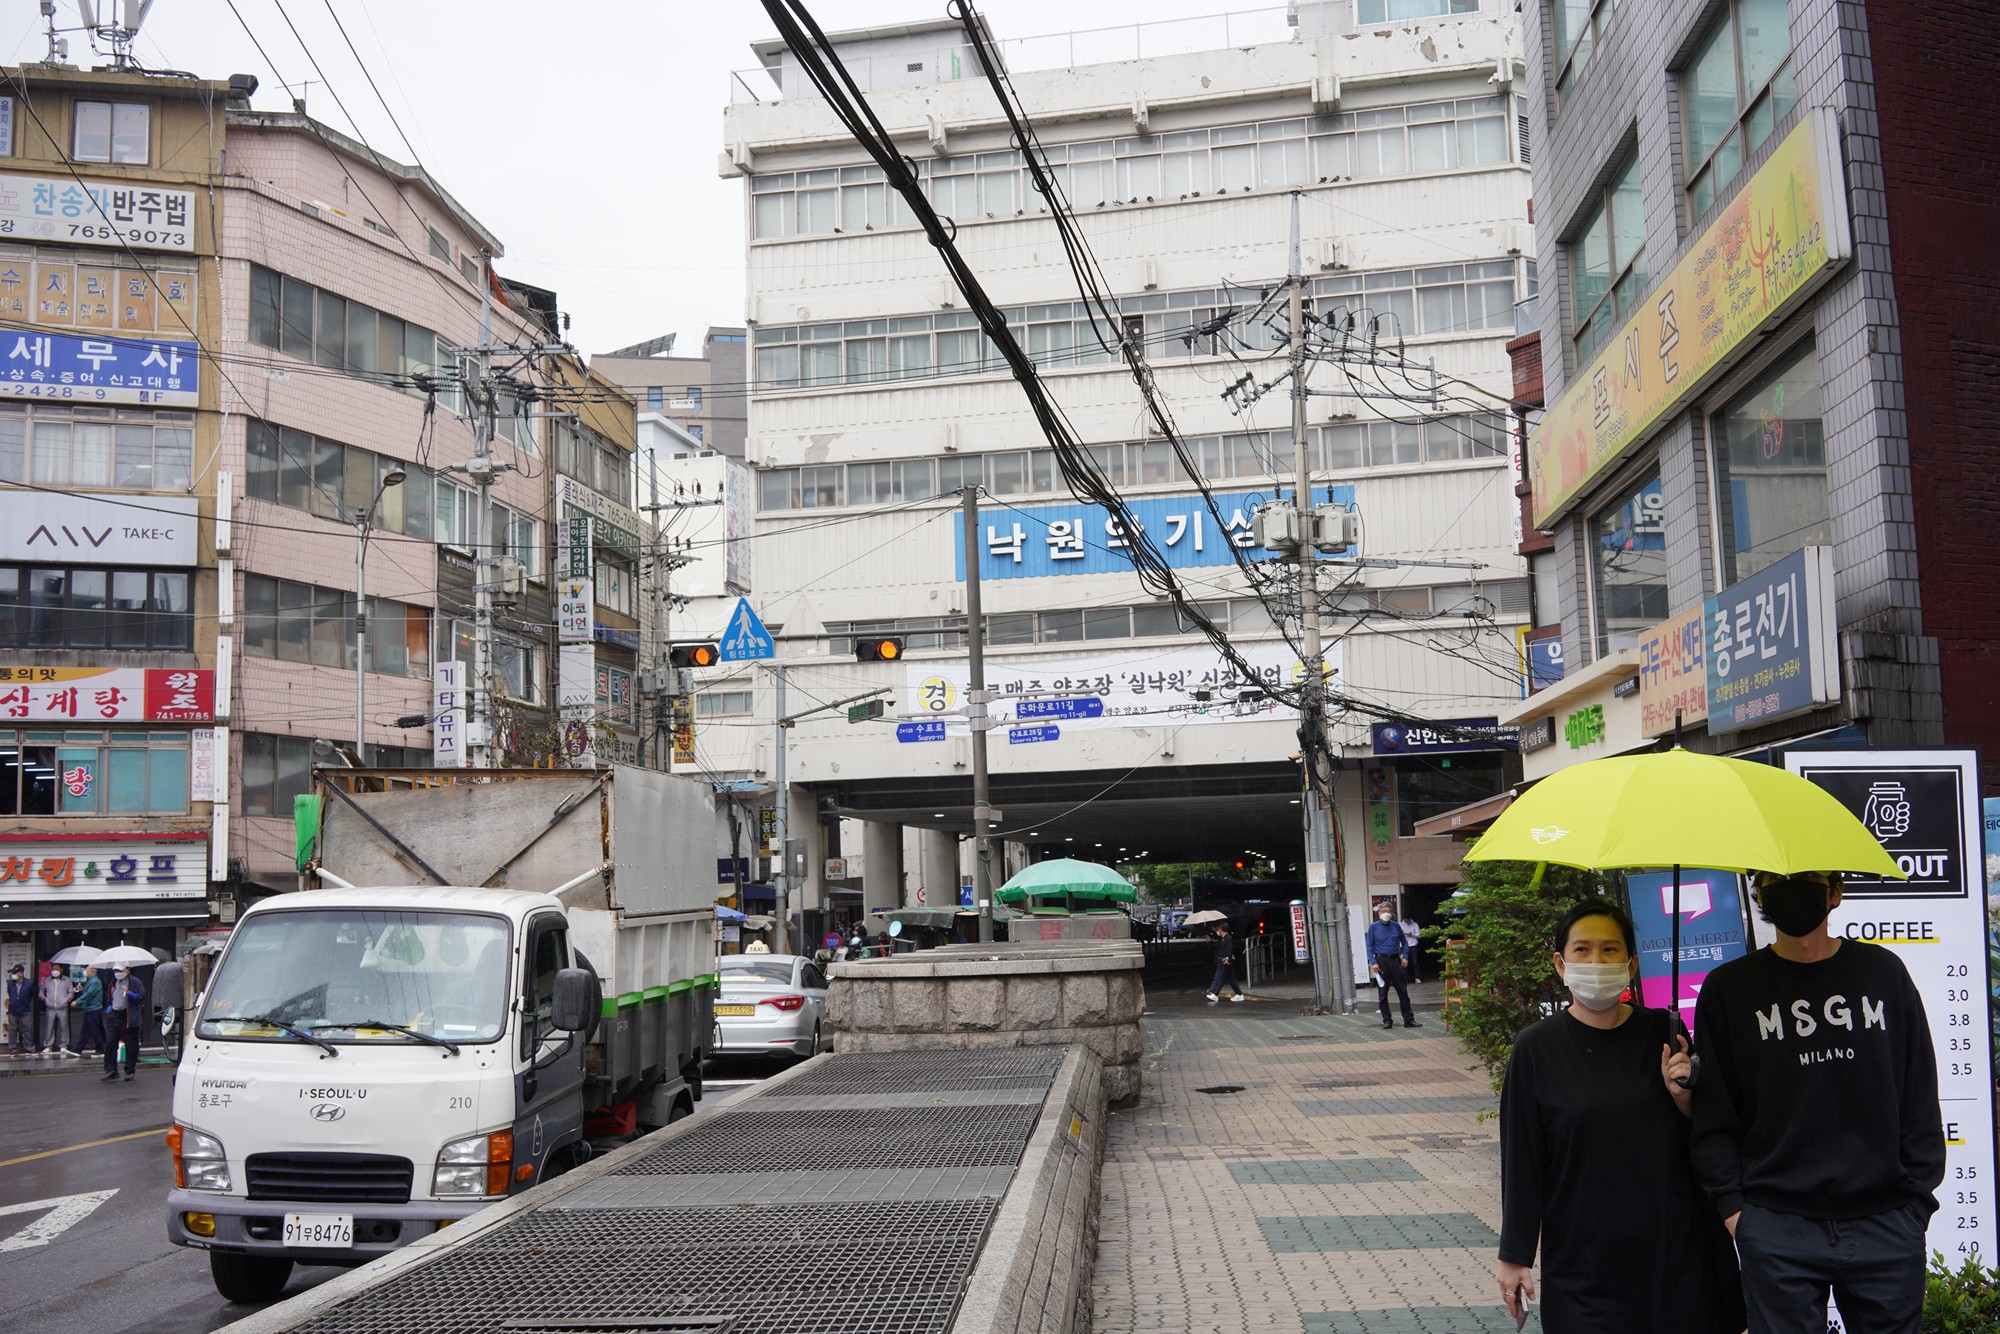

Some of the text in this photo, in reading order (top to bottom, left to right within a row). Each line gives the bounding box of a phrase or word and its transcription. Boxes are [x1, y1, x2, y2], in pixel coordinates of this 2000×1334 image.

[68, 224, 186, 245] 765-9073
[607, 504, 639, 534] 765-7678
[123, 527, 175, 541] TAKE-C
[1713, 573, 1799, 677] 종로전기
[729, 648, 766, 659] 횡단보도
[0, 686, 128, 718] 삼계탕
[1018, 701, 1075, 712] 돈화문로11길
[156, 711, 210, 721] 741-1785
[439, 668, 454, 752] 기타뮤즈
[916, 723, 944, 734] 수표로
[917, 734, 944, 742] Supyo-ro
[105, 854, 178, 881] 호프
[1292, 906, 1307, 949] 발관리
[1846, 922, 1934, 940] COFFEE
[1642, 931, 1740, 950] MOTL HERTZ
[1946, 964, 1969, 977] 2.0
[1947, 989, 1970, 1002] 3.0
[1755, 994, 1887, 1041] MSGM
[1949, 1014, 1971, 1026] 3.8
[1949, 1038, 1972, 1051] 3.5
[1799, 1047, 1855, 1066] MILANO
[1950, 1063, 1973, 1076] 3.5
[201, 1078, 248, 1090] HYUNDAI
[198, 1093, 233, 1108] 종로구
[449, 1097, 472, 1109] 210
[1955, 1167, 1977, 1180] 3.5
[1956, 1191, 1978, 1204] 3.5
[1957, 1216, 1979, 1229] 2.5
[1957, 1241, 1980, 1254] 4.0
